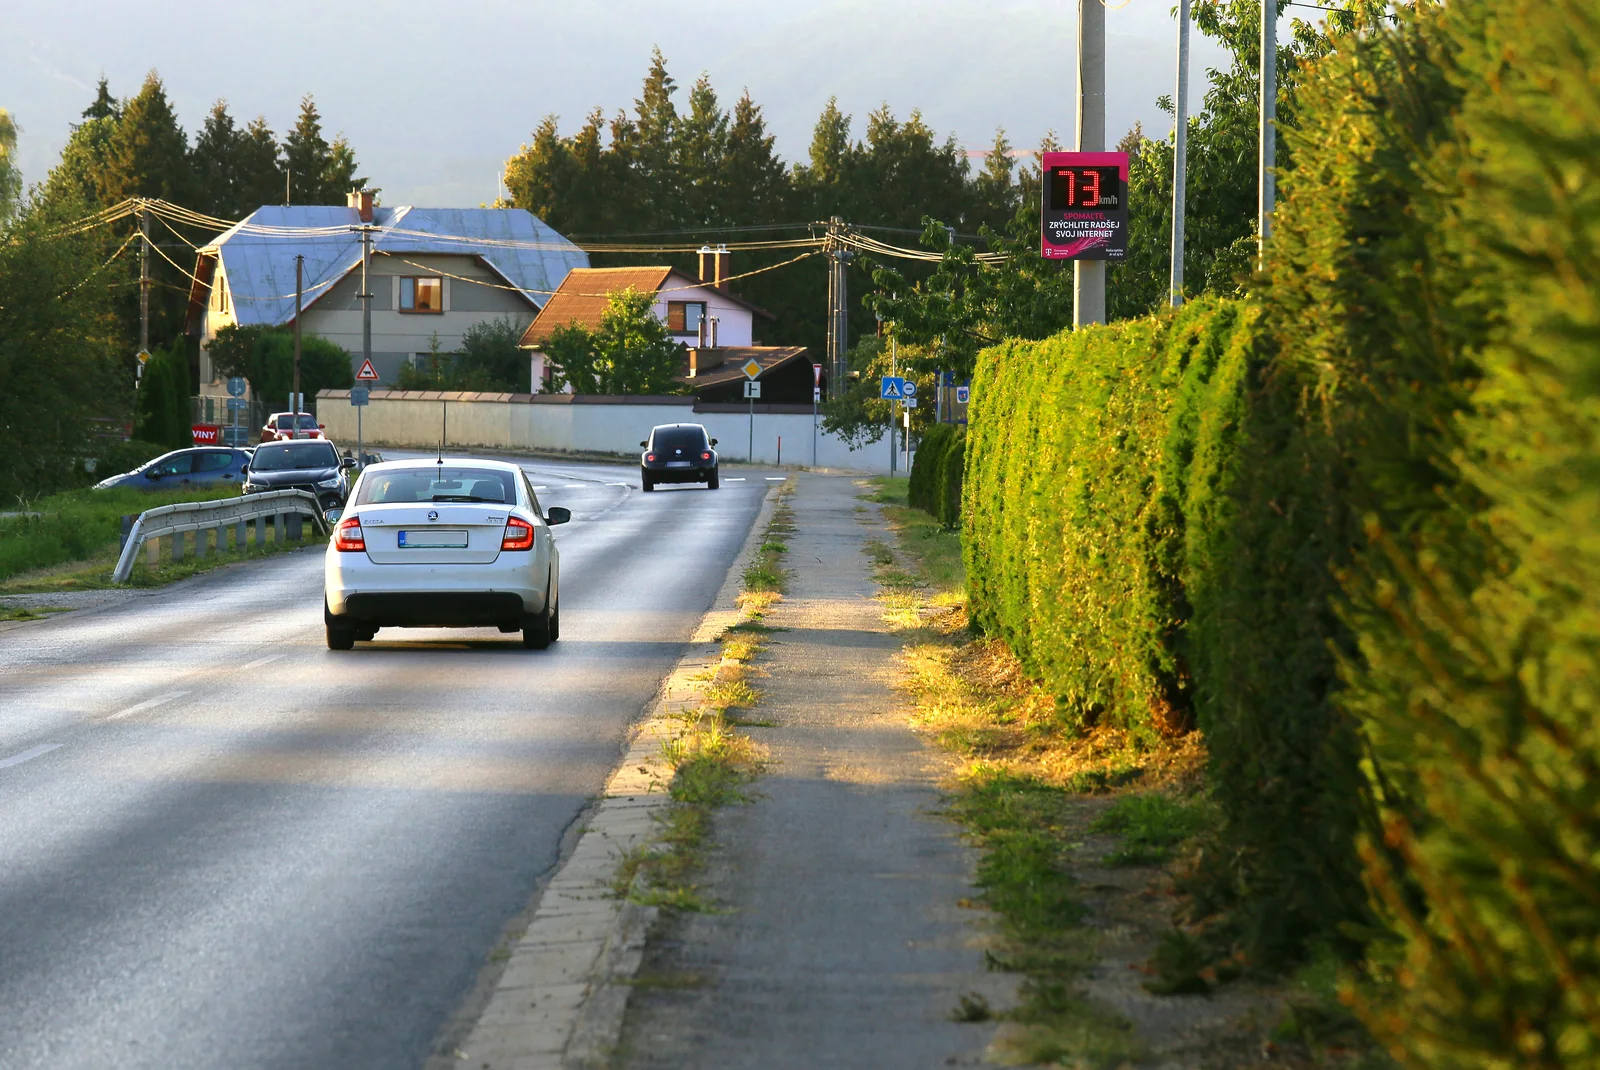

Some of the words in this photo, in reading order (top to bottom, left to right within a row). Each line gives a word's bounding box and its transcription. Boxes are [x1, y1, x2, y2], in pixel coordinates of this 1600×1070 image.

[1058, 170, 1099, 206] 73
[1098, 195, 1118, 205] km/h
[1049, 219, 1089, 229] ZRÝCHLITE
[1090, 219, 1120, 229] RADŠEJ
[1055, 230, 1076, 238] SVOJ
[1076, 230, 1113, 238] INTERNET
